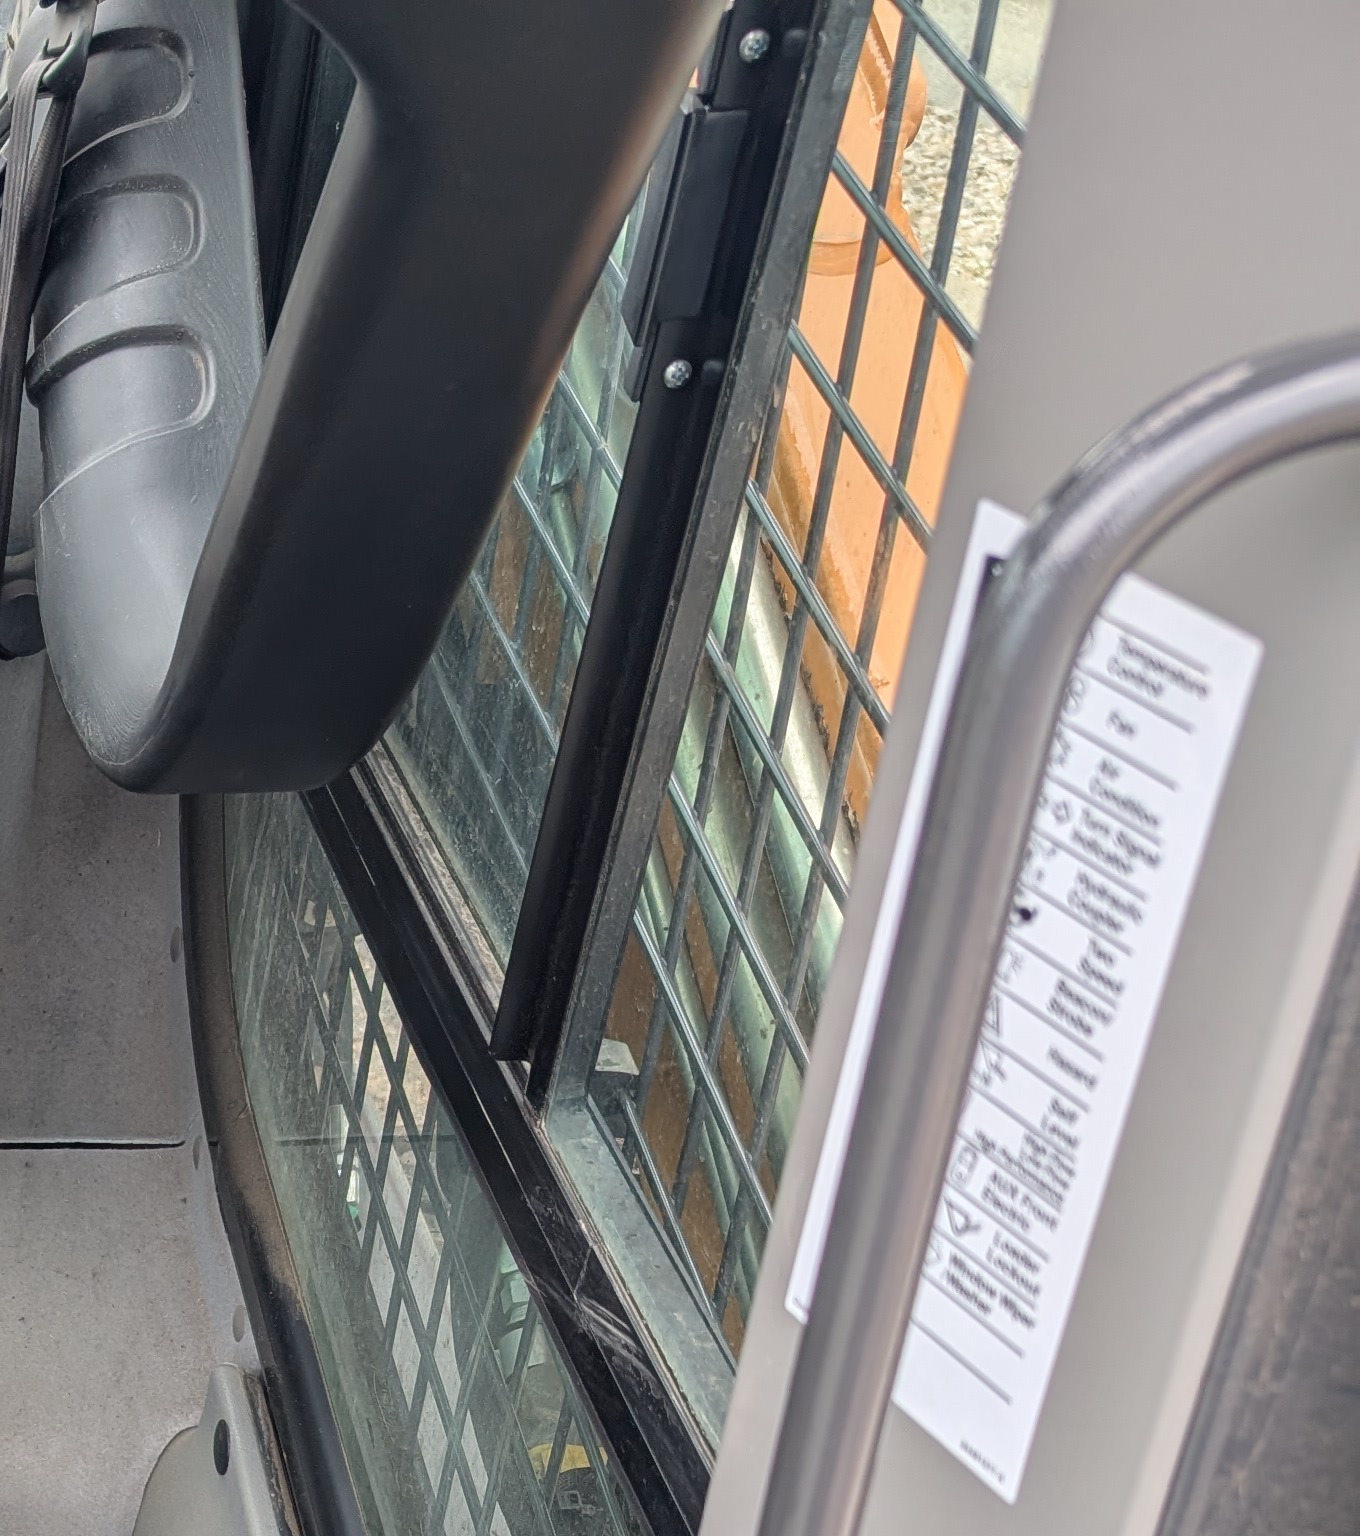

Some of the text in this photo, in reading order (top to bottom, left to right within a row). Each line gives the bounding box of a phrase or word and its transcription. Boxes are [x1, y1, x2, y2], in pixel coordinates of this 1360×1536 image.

[1107, 655, 1164, 698] Control
[1118, 636, 1211, 699] Temperature
[1089, 774, 1161, 828] Condition
